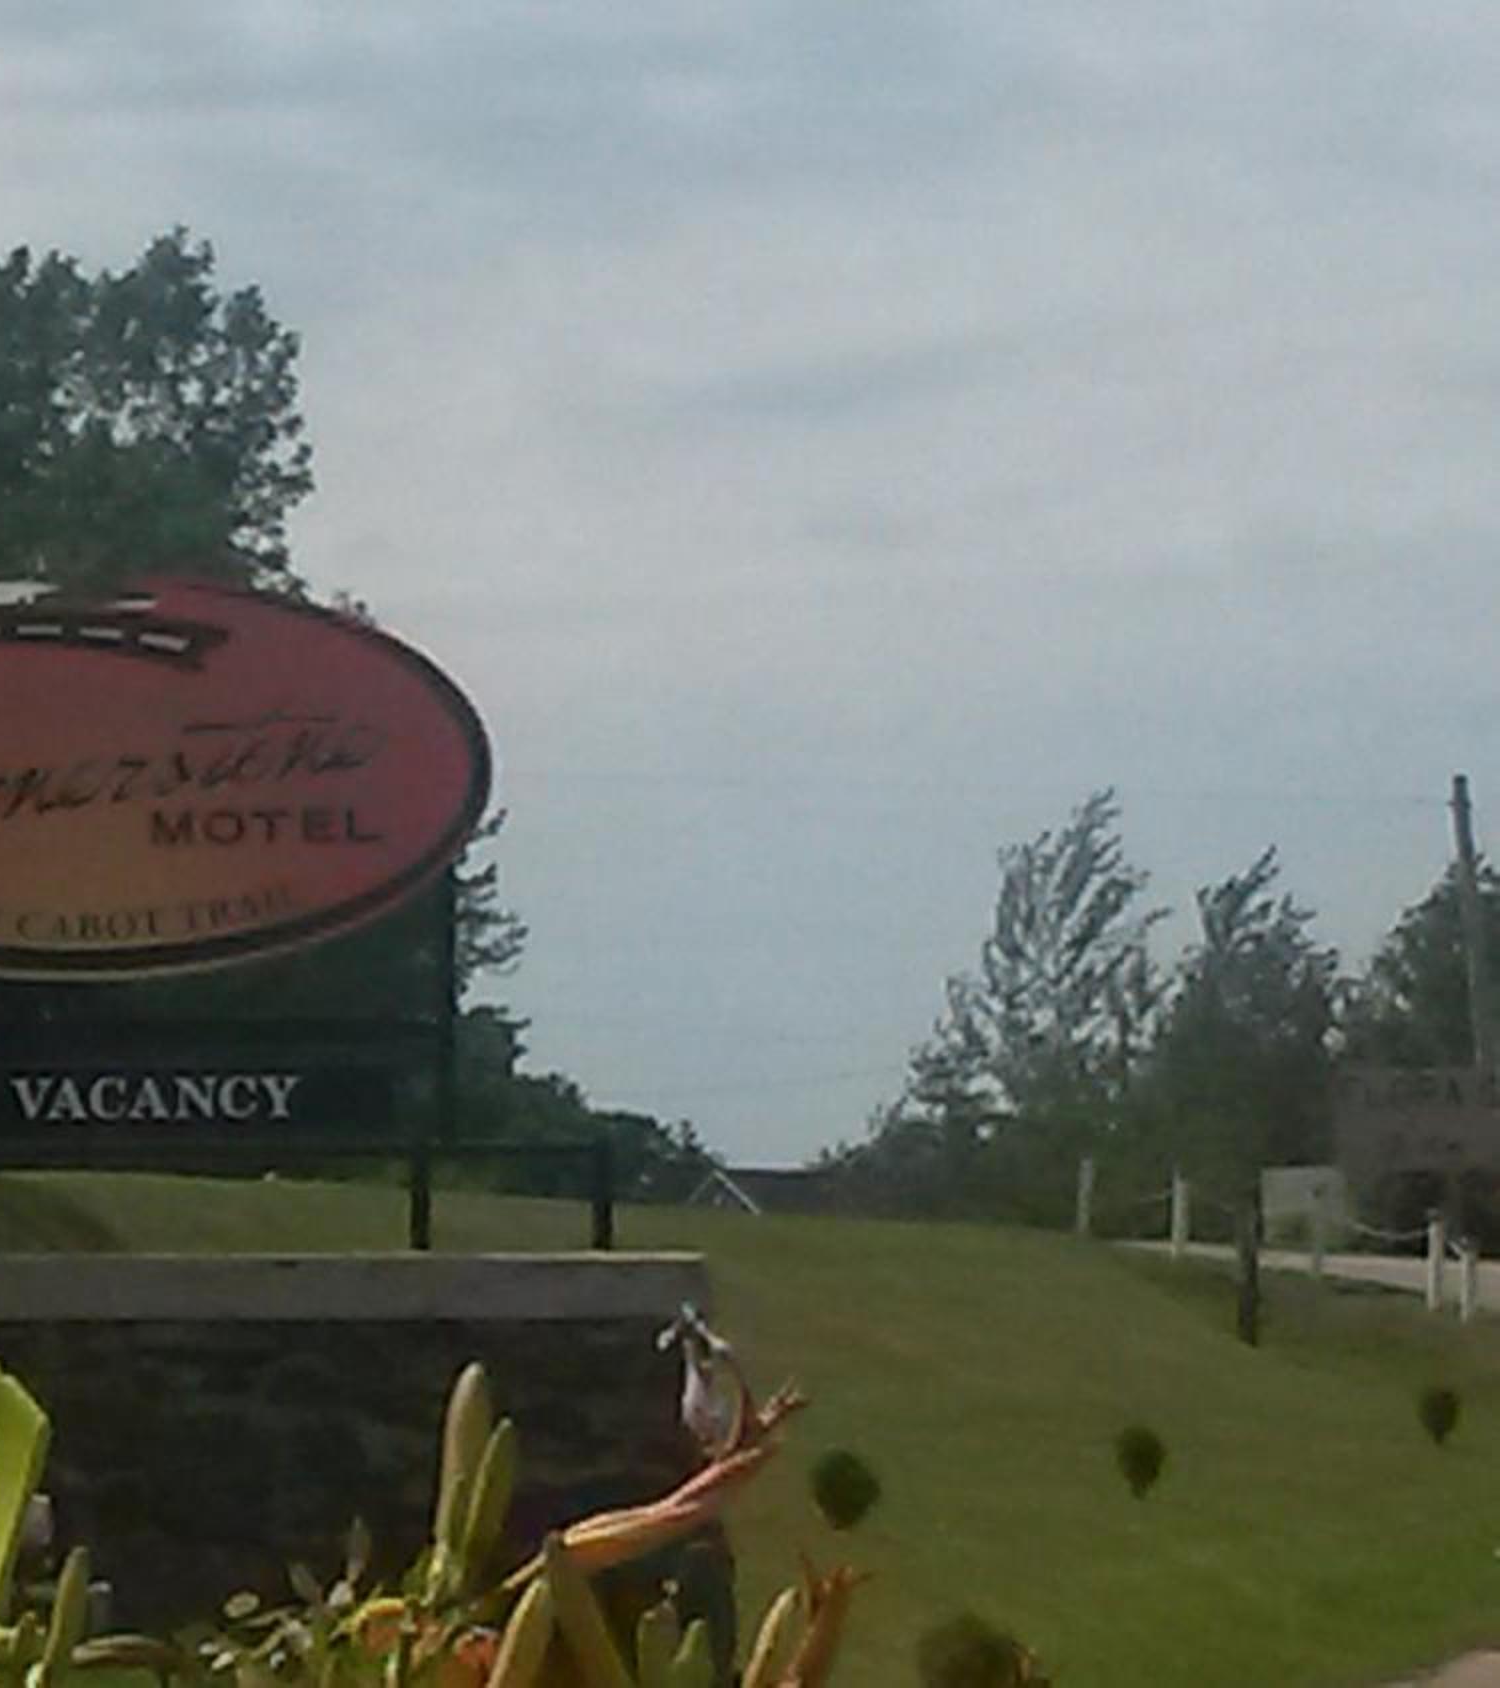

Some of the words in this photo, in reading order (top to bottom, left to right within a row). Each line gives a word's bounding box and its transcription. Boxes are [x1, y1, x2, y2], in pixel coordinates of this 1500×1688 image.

[150, 807, 384, 846] MOTEL
[14, 910, 164, 941] CABOT
[10, 1075, 300, 1120] VACANCY
